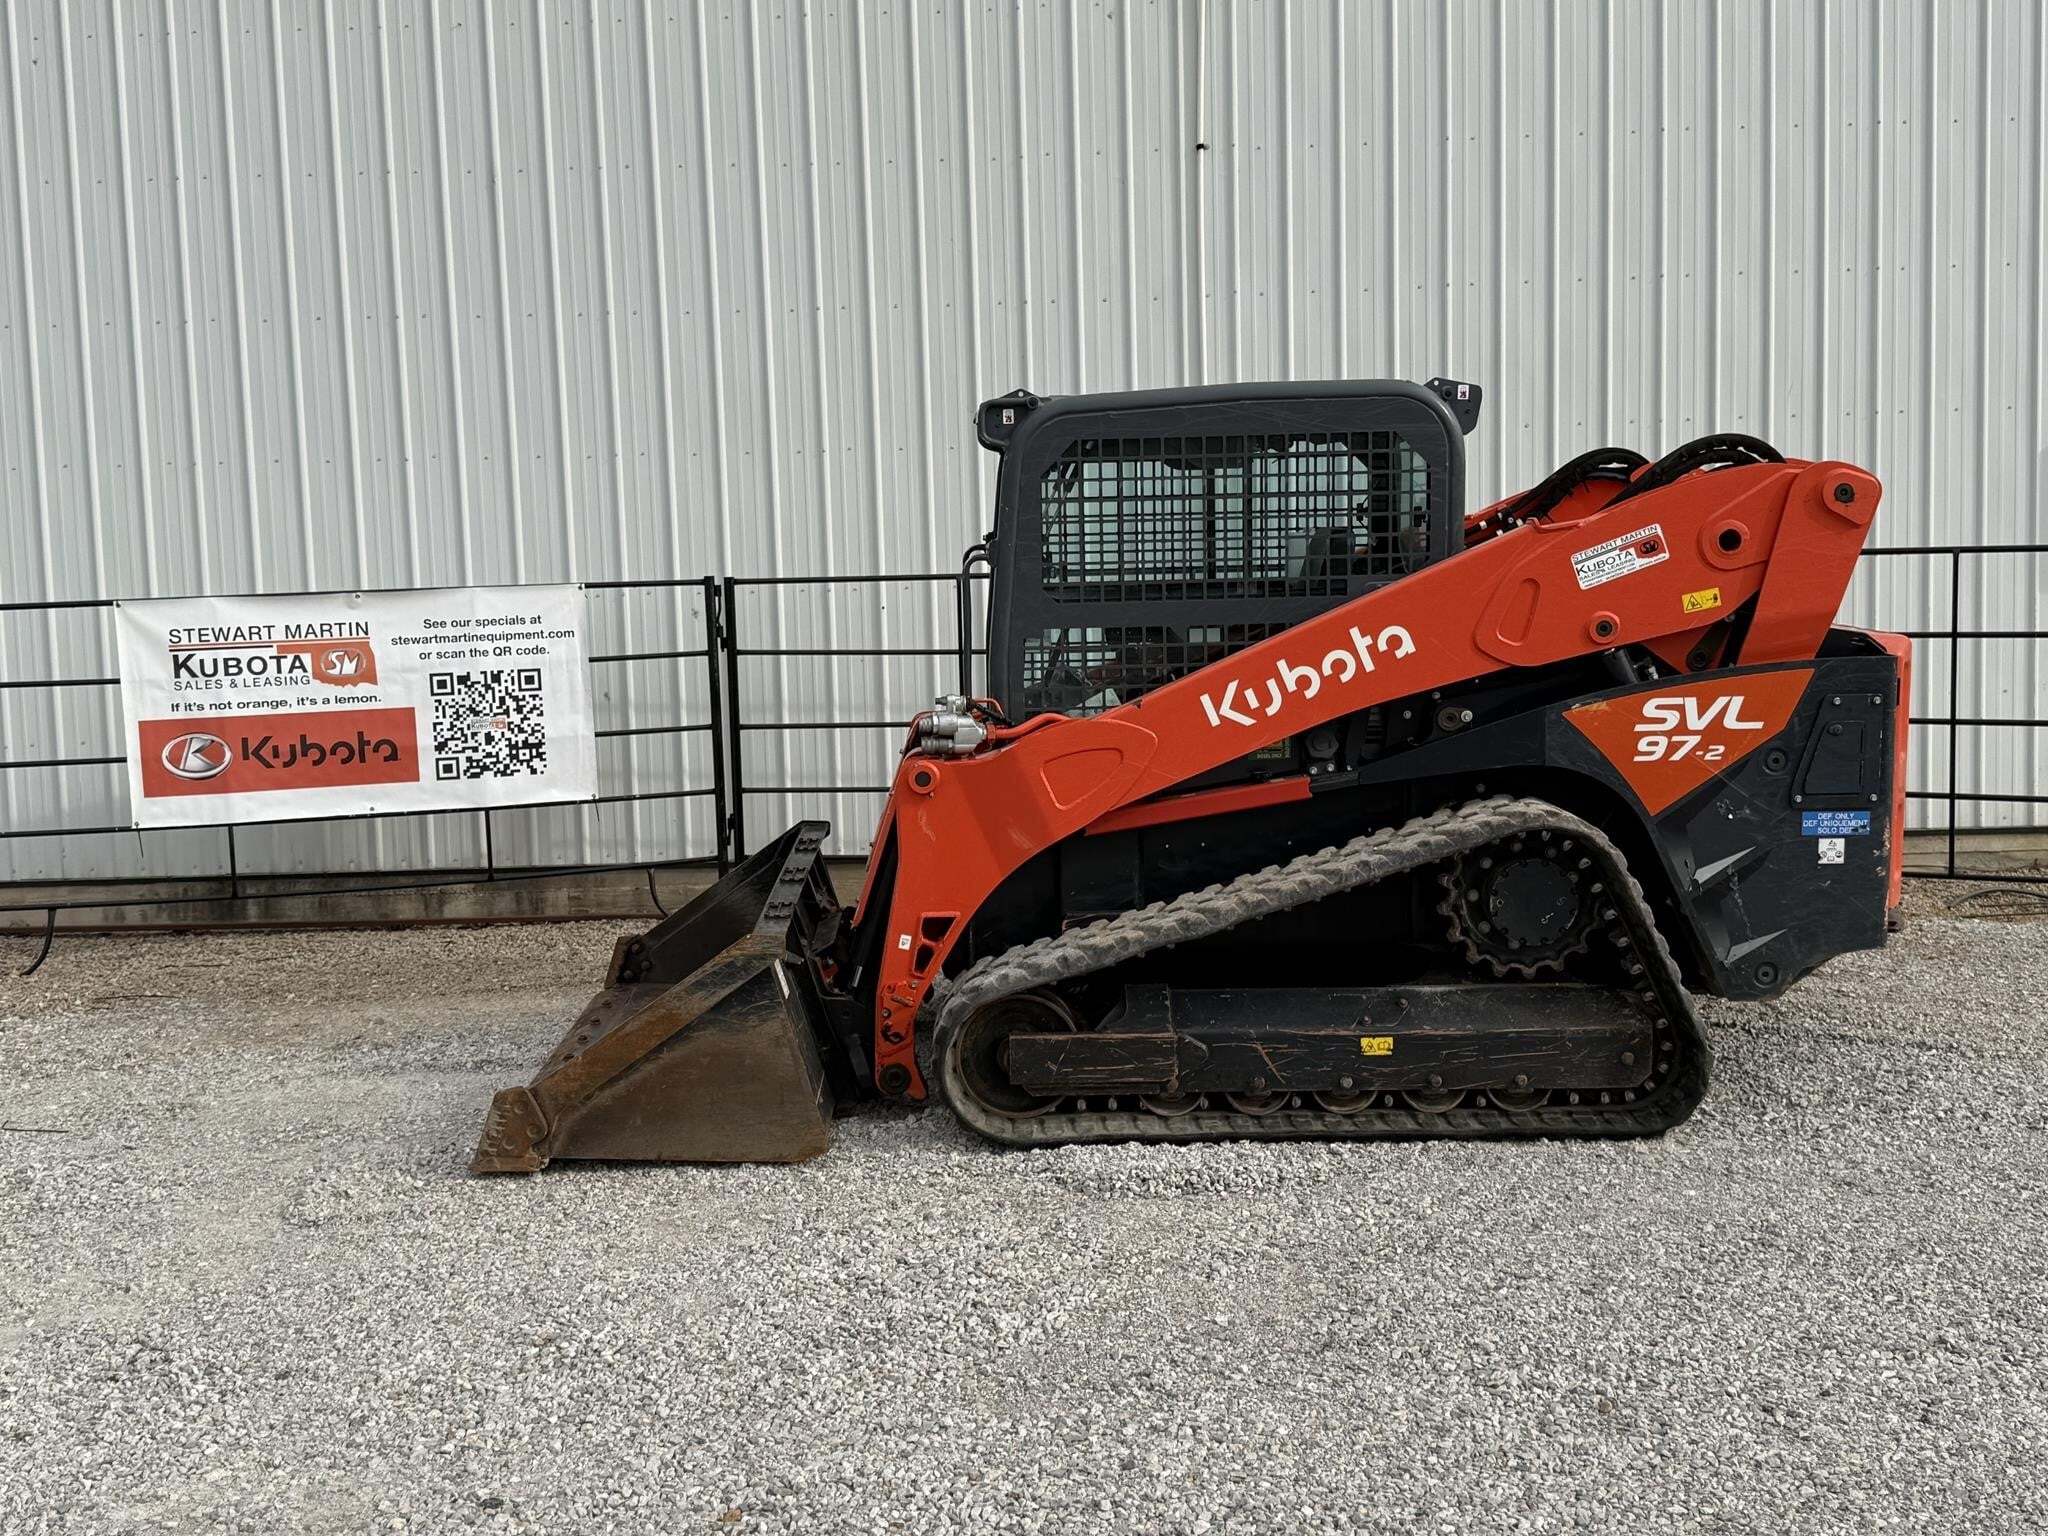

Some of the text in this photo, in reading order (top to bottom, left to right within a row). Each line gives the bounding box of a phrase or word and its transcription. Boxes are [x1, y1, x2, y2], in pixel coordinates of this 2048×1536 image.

[1573, 525, 1658, 561] STEWART MARTIN
[1576, 550, 1634, 576] KUBOTA
[1606, 557, 1636, 571] LEASING
[423, 614, 542, 630] See our specials at
[168, 621, 370, 644] STEWART MARTIN
[391, 629, 575, 647] stewartmartinequipment.com
[419, 645, 550, 660] or scan the QR code.
[172, 653, 308, 679] KUBOTA
[173, 675, 311, 691] SALES & LEASING
[1200, 625, 1416, 727] Kubota
[171, 694, 382, 713] If it's not orange, it's a lemon.
[1633, 696, 1764, 731] SVL
[241, 731, 399, 769] Kubota
[1633, 735, 1726, 762] 97-2
[1817, 812, 1855, 820] DEF ONLY
[1820, 819, 1869, 827] UNIQUEMENT
[1817, 826, 1837, 834] SOLO
